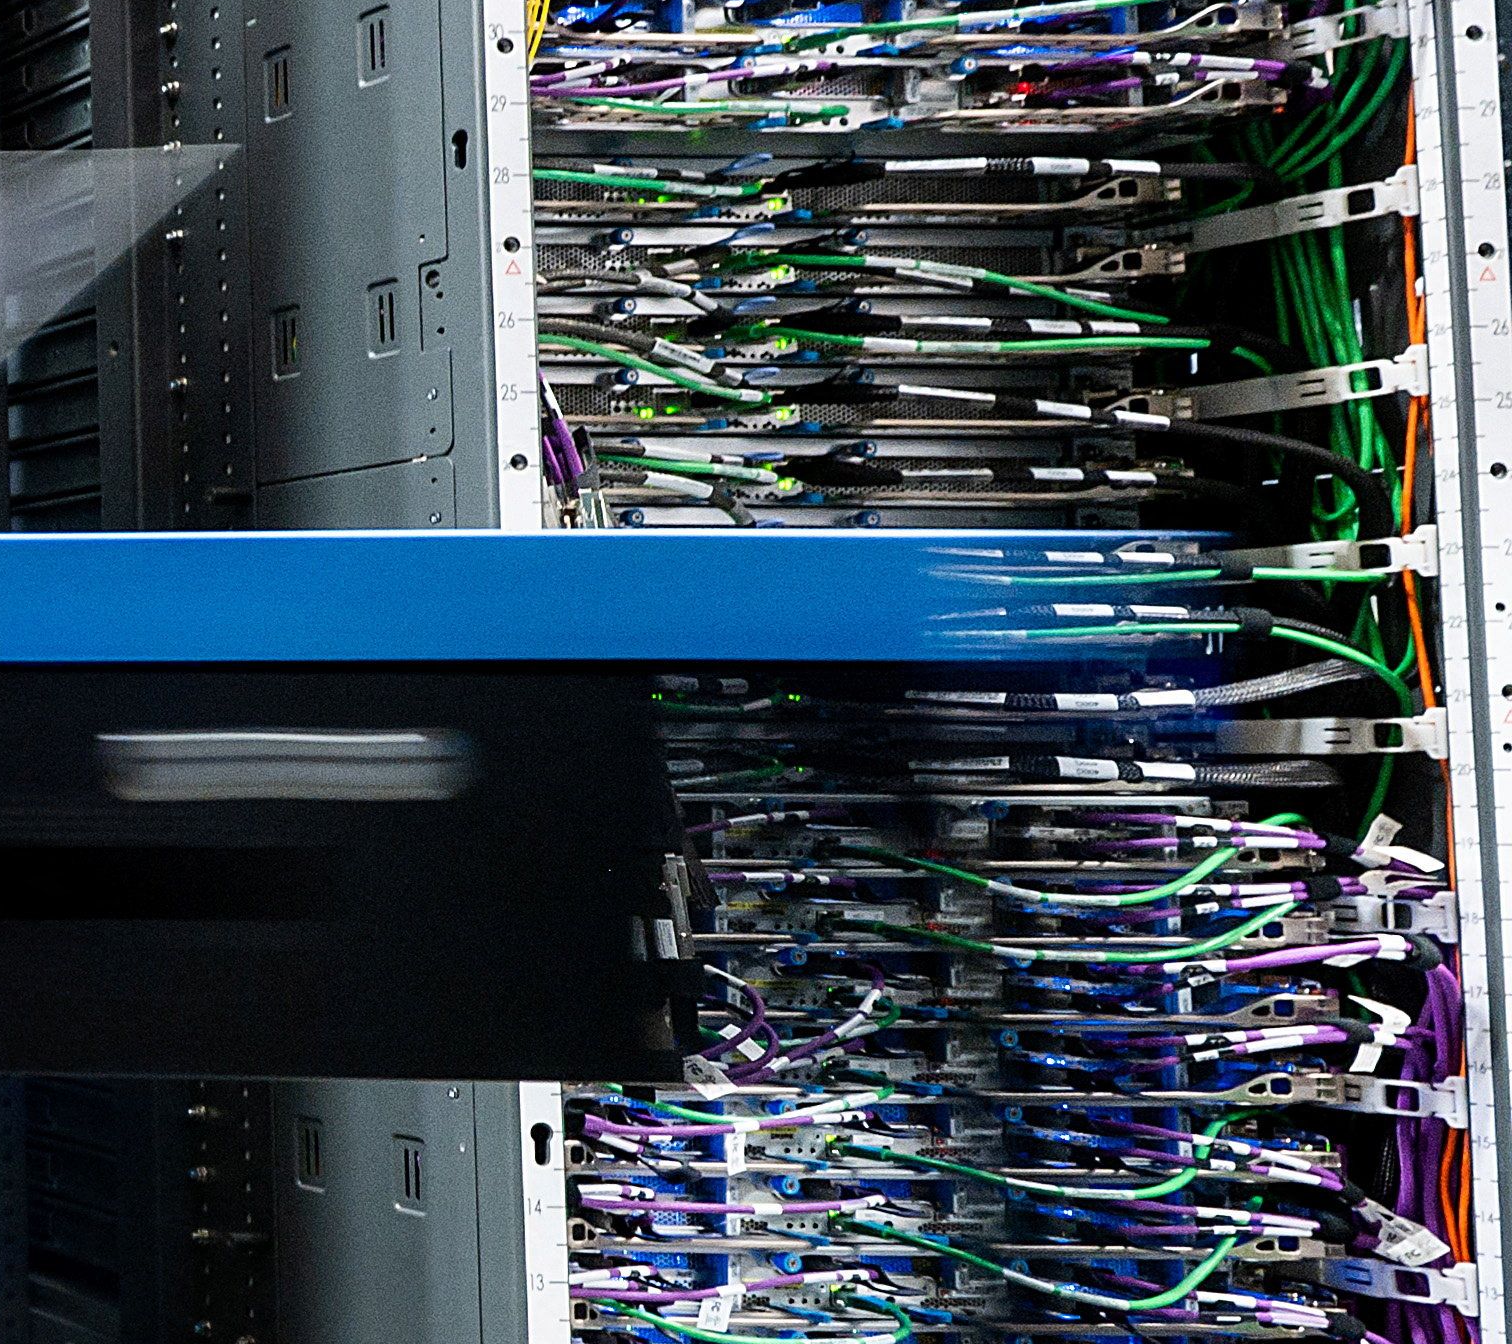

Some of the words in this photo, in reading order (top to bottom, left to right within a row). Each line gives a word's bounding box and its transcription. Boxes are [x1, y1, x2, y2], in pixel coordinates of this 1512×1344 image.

[491, 96, 505, 112] 29
[494, 168, 508, 184] 28
[500, 313, 512, 327] 26
[502, 385, 516, 401] 25
[528, 1199, 541, 1213] 14
[532, 1274, 544, 1290] 13
